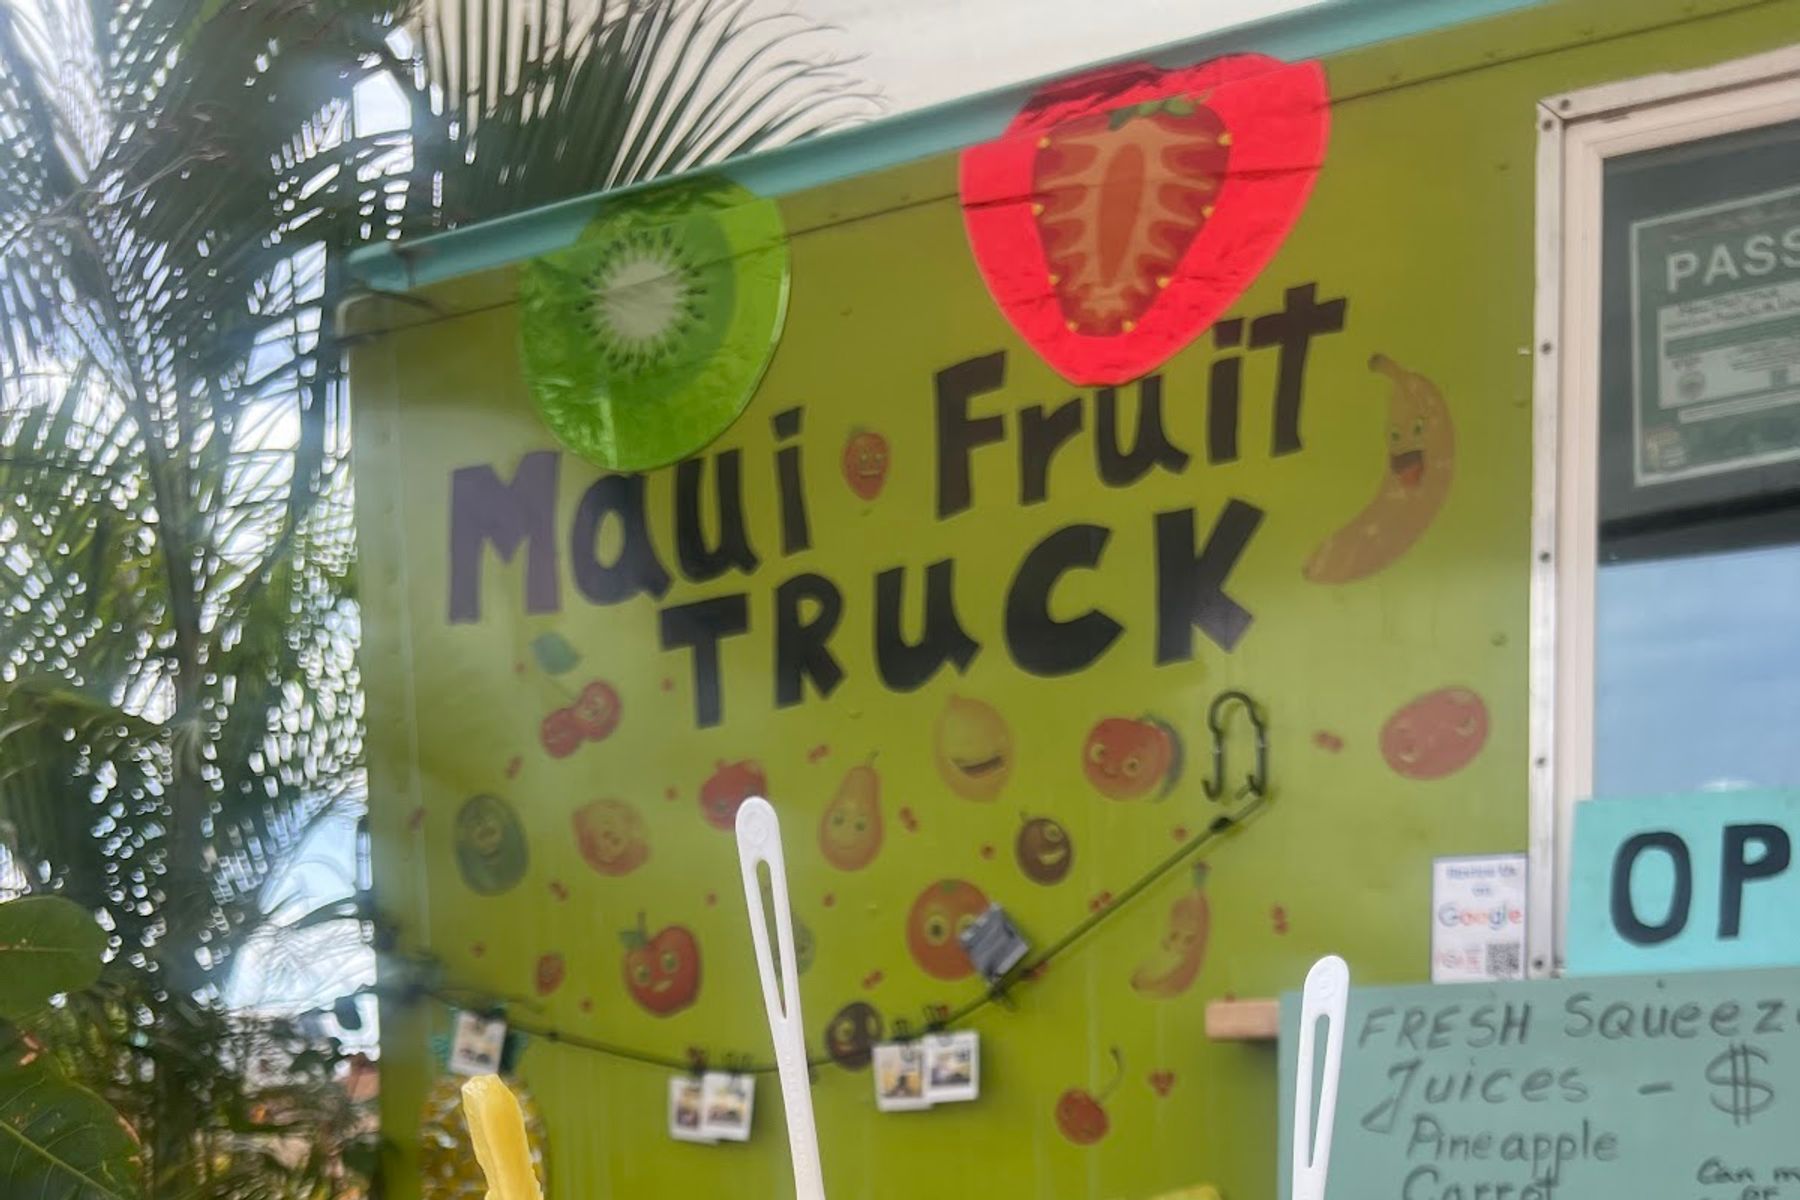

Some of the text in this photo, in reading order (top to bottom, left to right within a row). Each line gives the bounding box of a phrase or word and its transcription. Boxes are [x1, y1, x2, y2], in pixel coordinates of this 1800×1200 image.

[447, 282, 1348, 625] Maui Fruit
[1438, 901, 1523, 931] Google
[1609, 822, 1792, 946] OP
[1357, 991, 1800, 1051] FRESH SQueez
[1360, 1056, 1589, 1136] Juices
[1704, 1043, 1775, 1127] $
